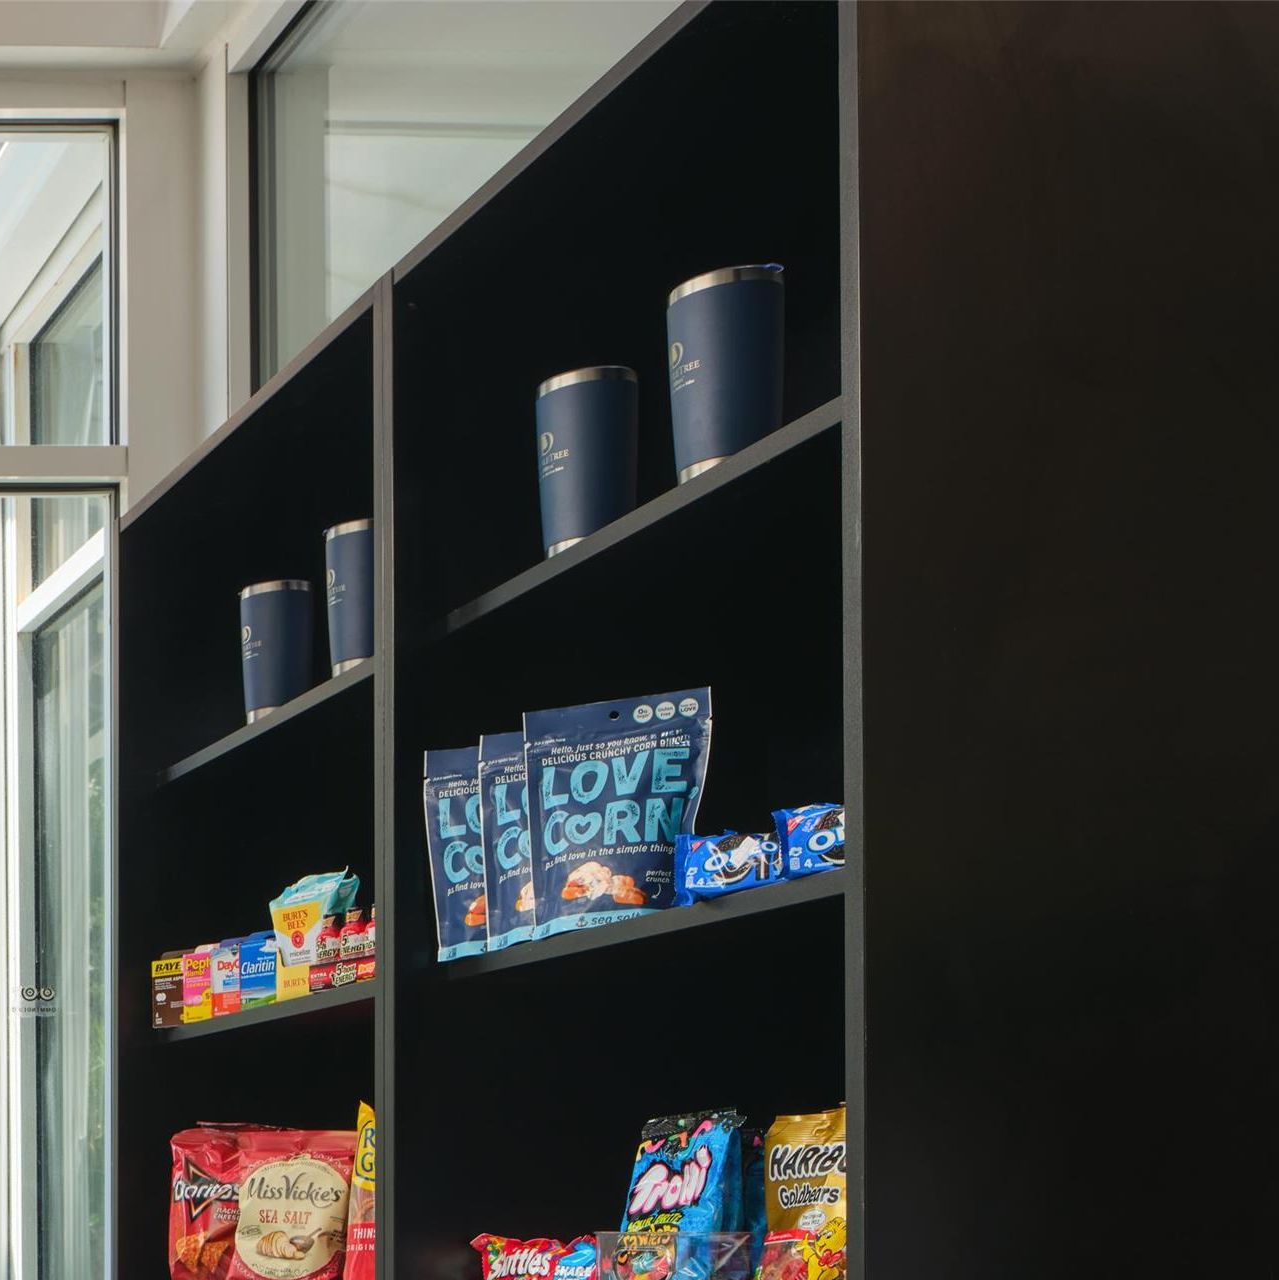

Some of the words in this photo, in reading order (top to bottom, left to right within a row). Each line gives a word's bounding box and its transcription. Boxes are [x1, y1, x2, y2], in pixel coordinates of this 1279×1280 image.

[542, 750, 587, 767] DELICIOUS
[589, 745, 632, 760] CRUNCHY
[633, 740, 657, 753] CORN
[607, 739, 622, 752] you
[568, 852, 586, 861] love
[588, 849, 596, 857] in
[602, 847, 614, 855] the
[616, 844, 648, 855] simple
[645, 870, 672, 878] perfect
[283, 908, 308, 922] BURT'S
[287, 920, 306, 930] BEES
[241, 959, 275, 975] Claritin
[174, 1179, 240, 1201] Doritos
[248, 1178, 283, 1201] Miss
[282, 1172, 342, 1208] Vickie's
[779, 1183, 840, 1209] Goldbears
[259, 1209, 279, 1224] SEA
[283, 1210, 313, 1225] SALT
[487, 1247, 551, 1280] Skittles
